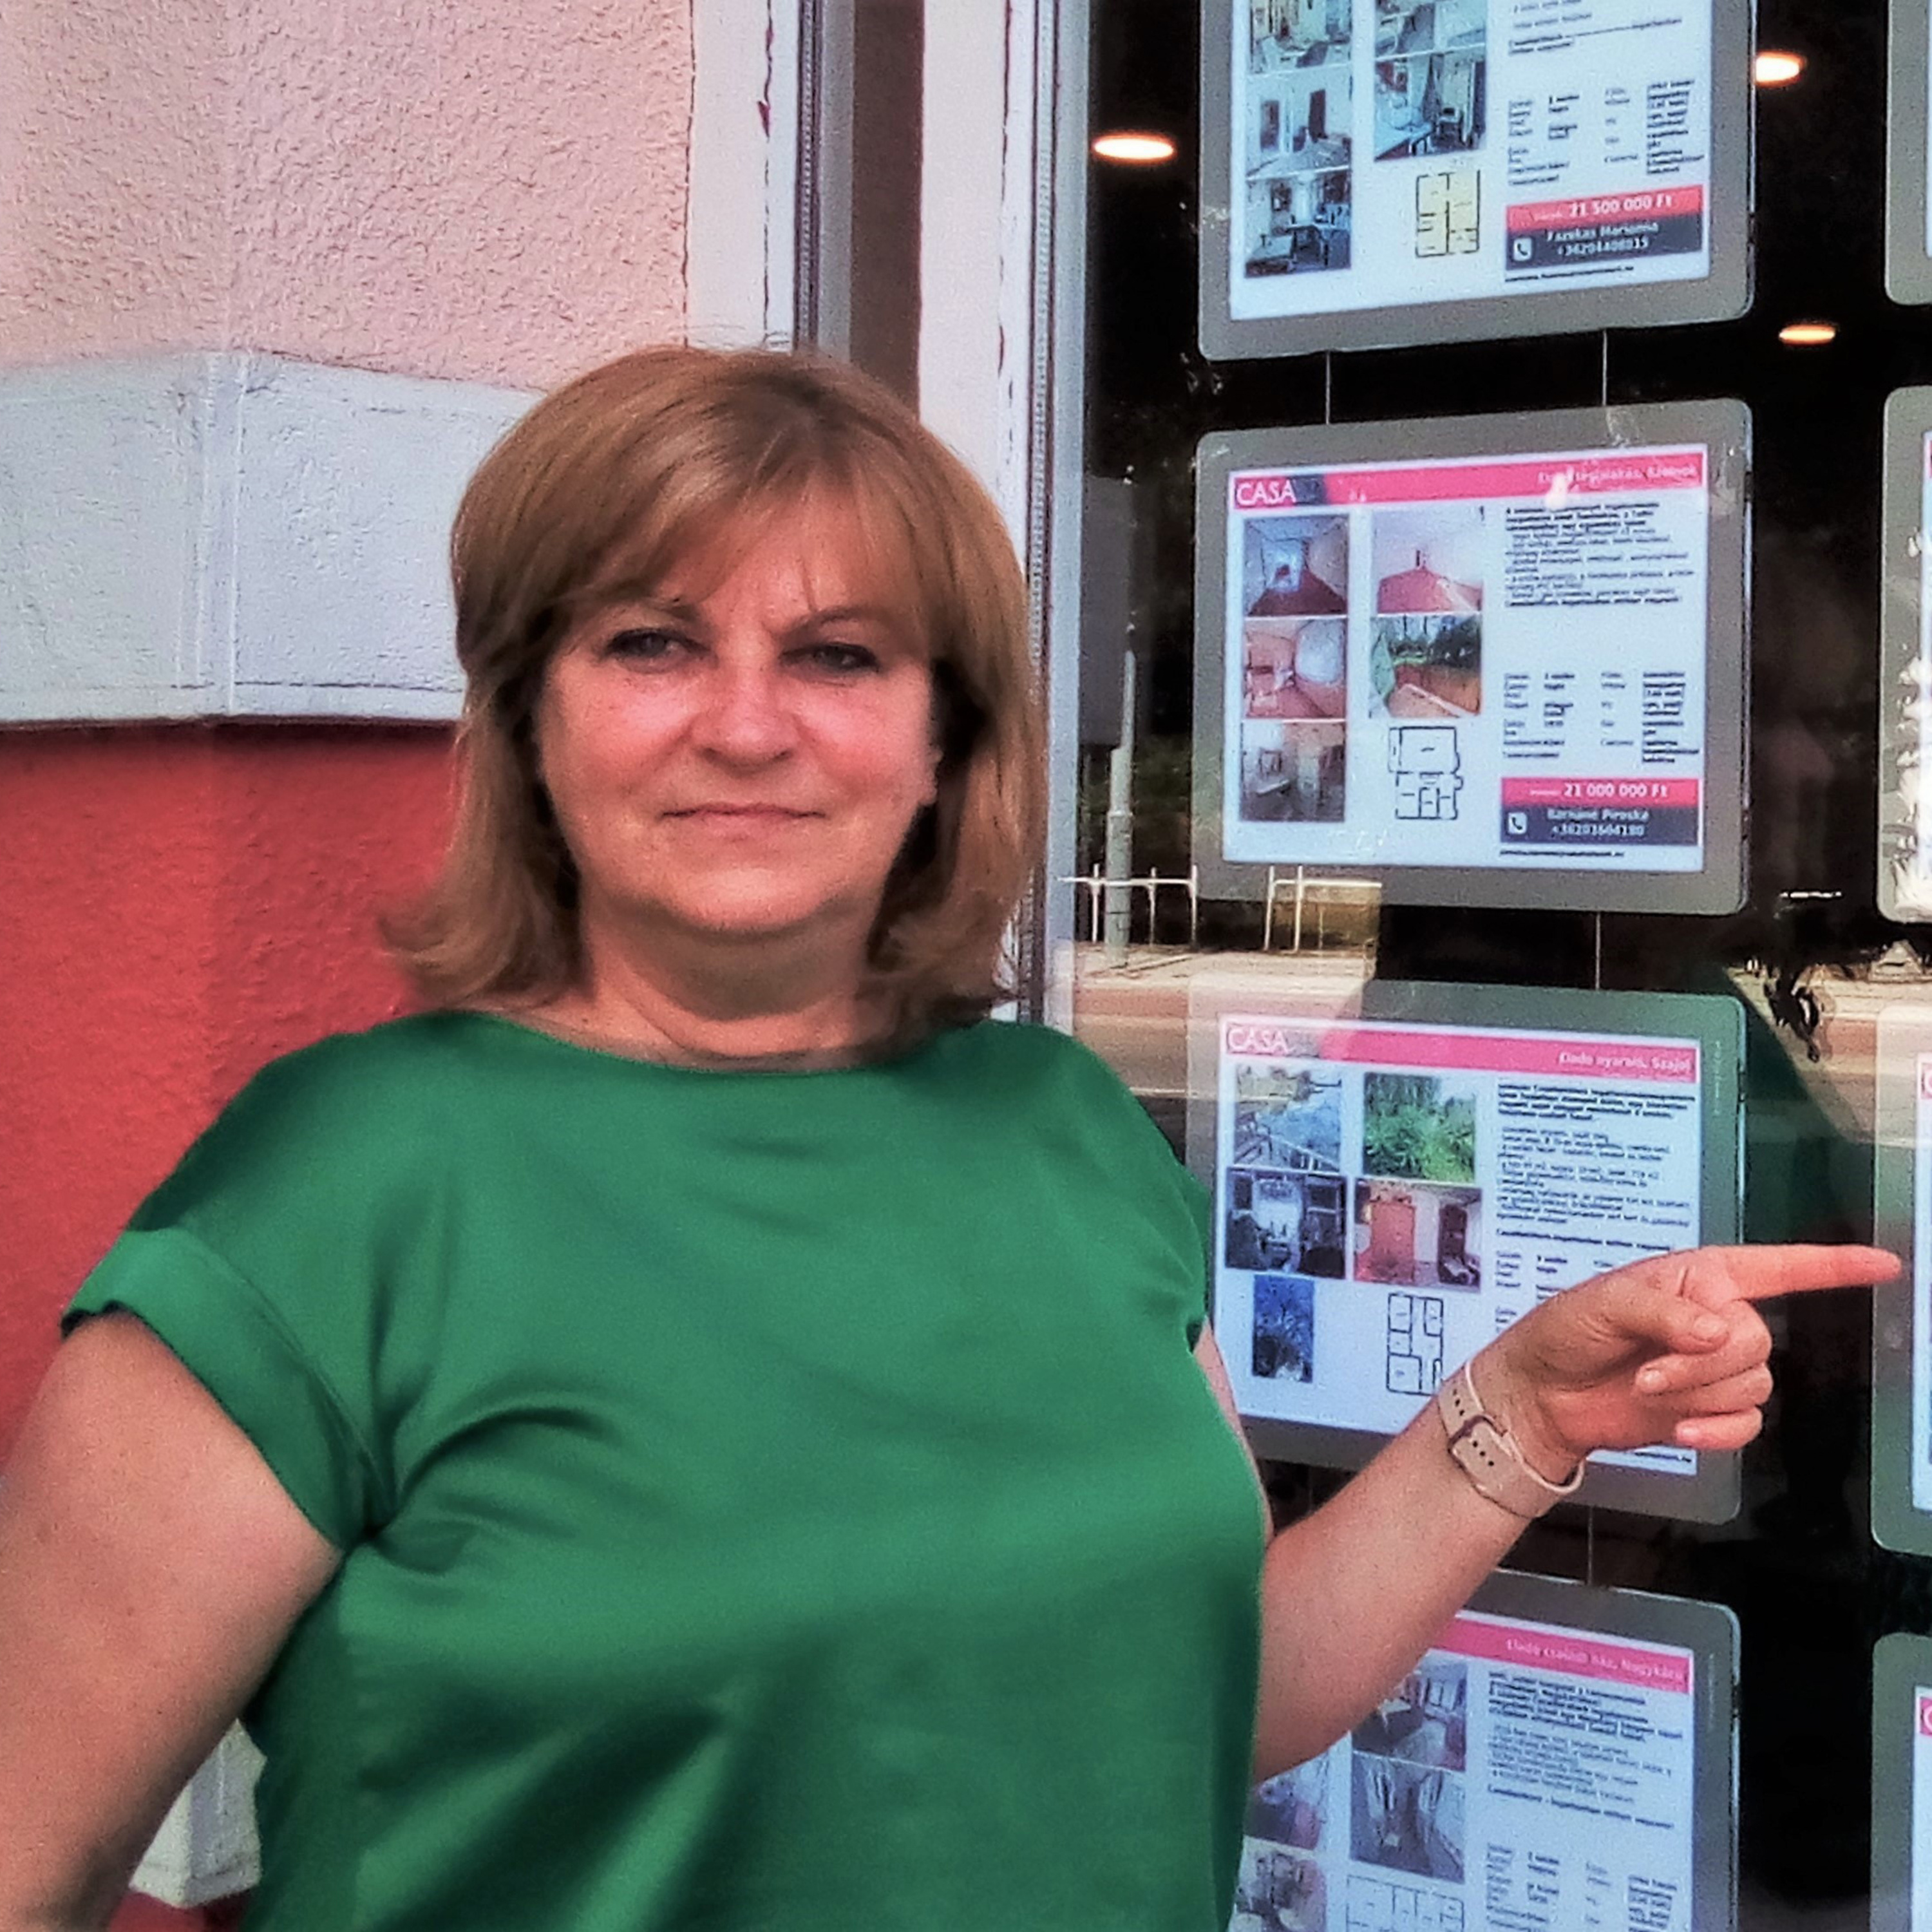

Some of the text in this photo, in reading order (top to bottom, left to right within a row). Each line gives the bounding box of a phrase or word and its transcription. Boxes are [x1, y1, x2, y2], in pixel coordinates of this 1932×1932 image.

[1623, 195, 1652, 211] 000
[1655, 194, 1673, 208] Ft
[1236, 479, 1297, 506] CASA
[1564, 782, 1582, 797] 21
[1586, 782, 1615, 797] 000
[1618, 782, 1647, 797] 000
[1651, 782, 1669, 798] Ft
[1228, 1027, 1289, 1054] CASA
